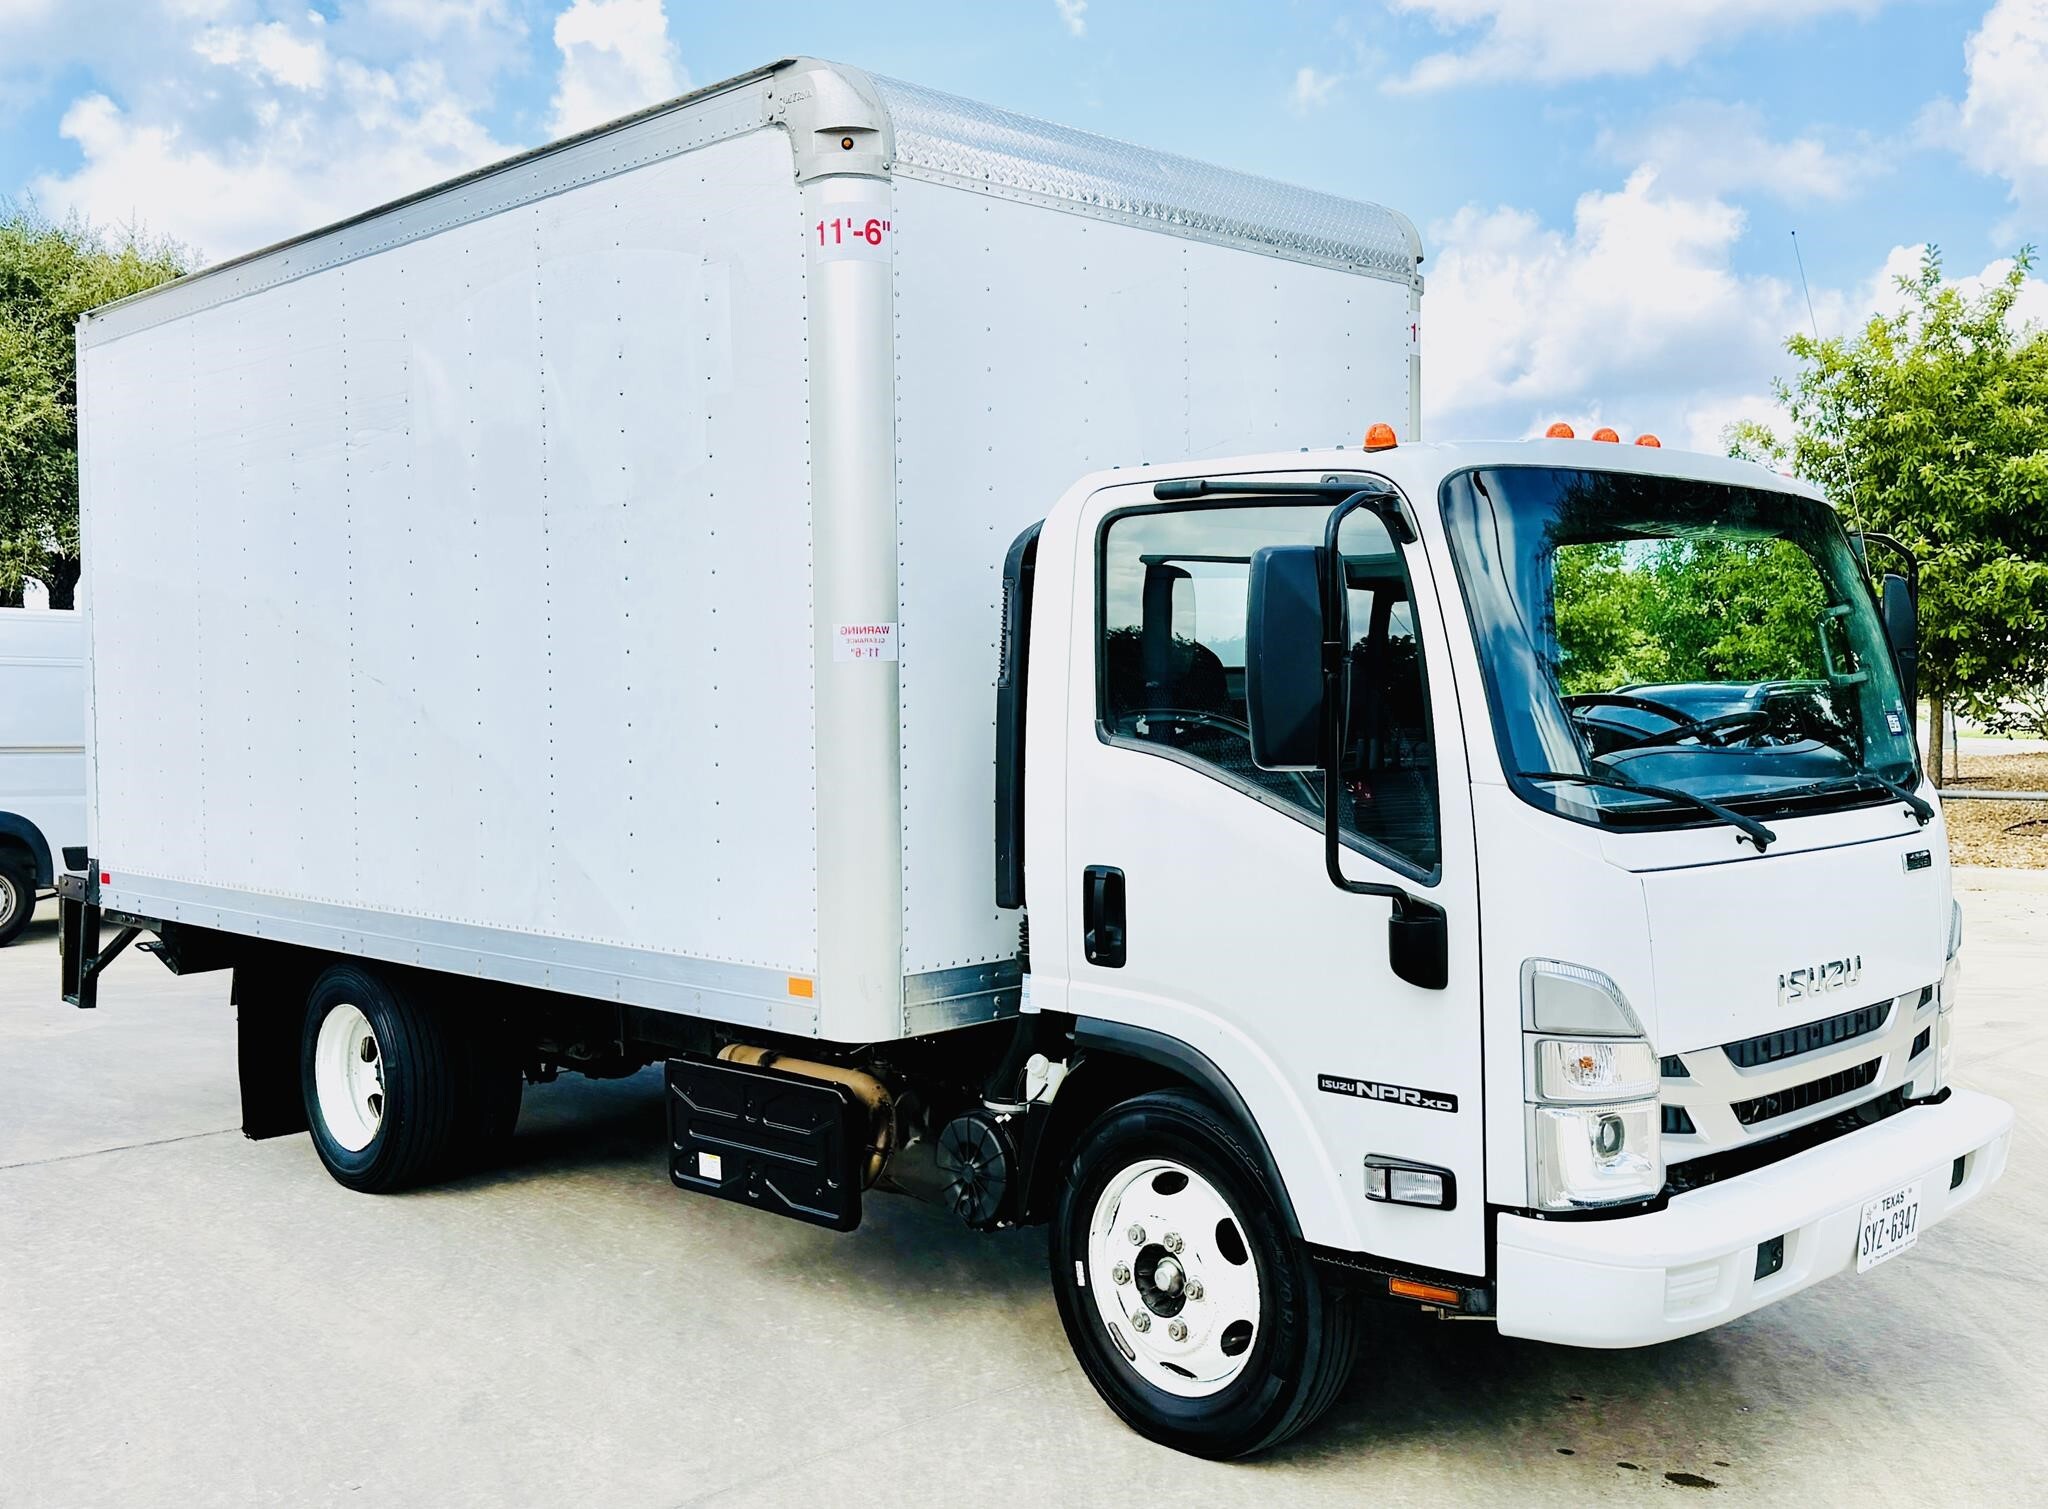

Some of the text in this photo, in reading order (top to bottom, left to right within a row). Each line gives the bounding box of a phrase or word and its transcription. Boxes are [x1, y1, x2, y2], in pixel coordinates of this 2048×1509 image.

[816, 217, 891, 246] 11'-6"
[1777, 955, 1862, 1007] ISUZU
[1322, 1079, 1355, 1092] ISUZU
[1881, 1191, 1905, 1212] TEXAS
